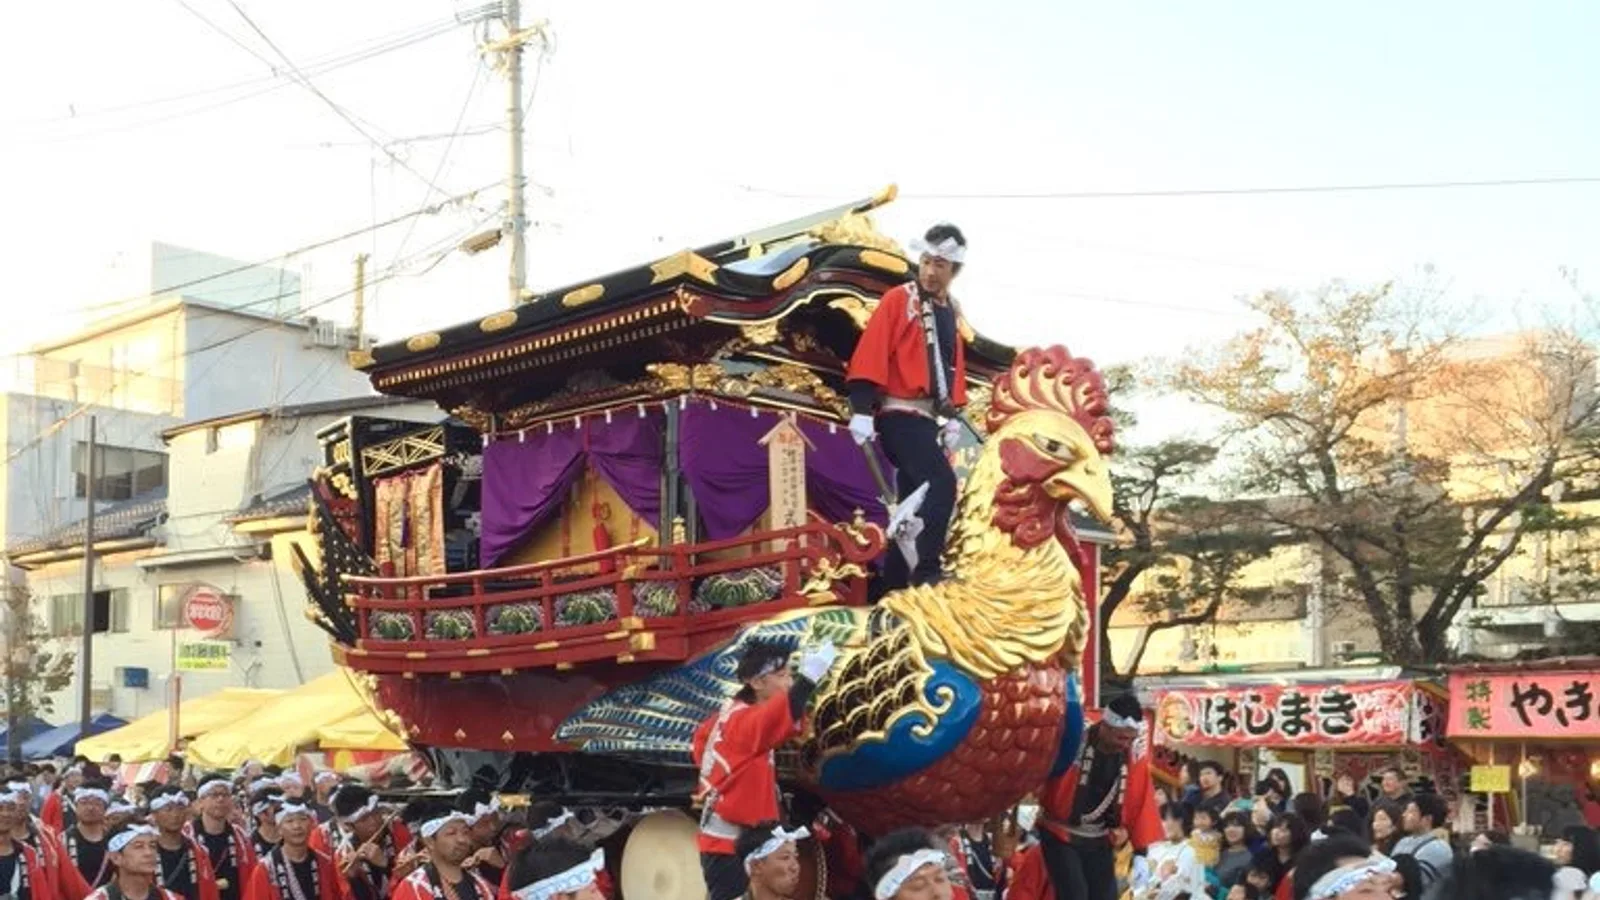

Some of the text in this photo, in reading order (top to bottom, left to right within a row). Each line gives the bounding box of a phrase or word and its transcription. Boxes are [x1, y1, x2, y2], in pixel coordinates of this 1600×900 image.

[1202, 689, 1358, 736] はしまき
[1466, 680, 1492, 730] 特製
[1510, 680, 1600, 728] やき
